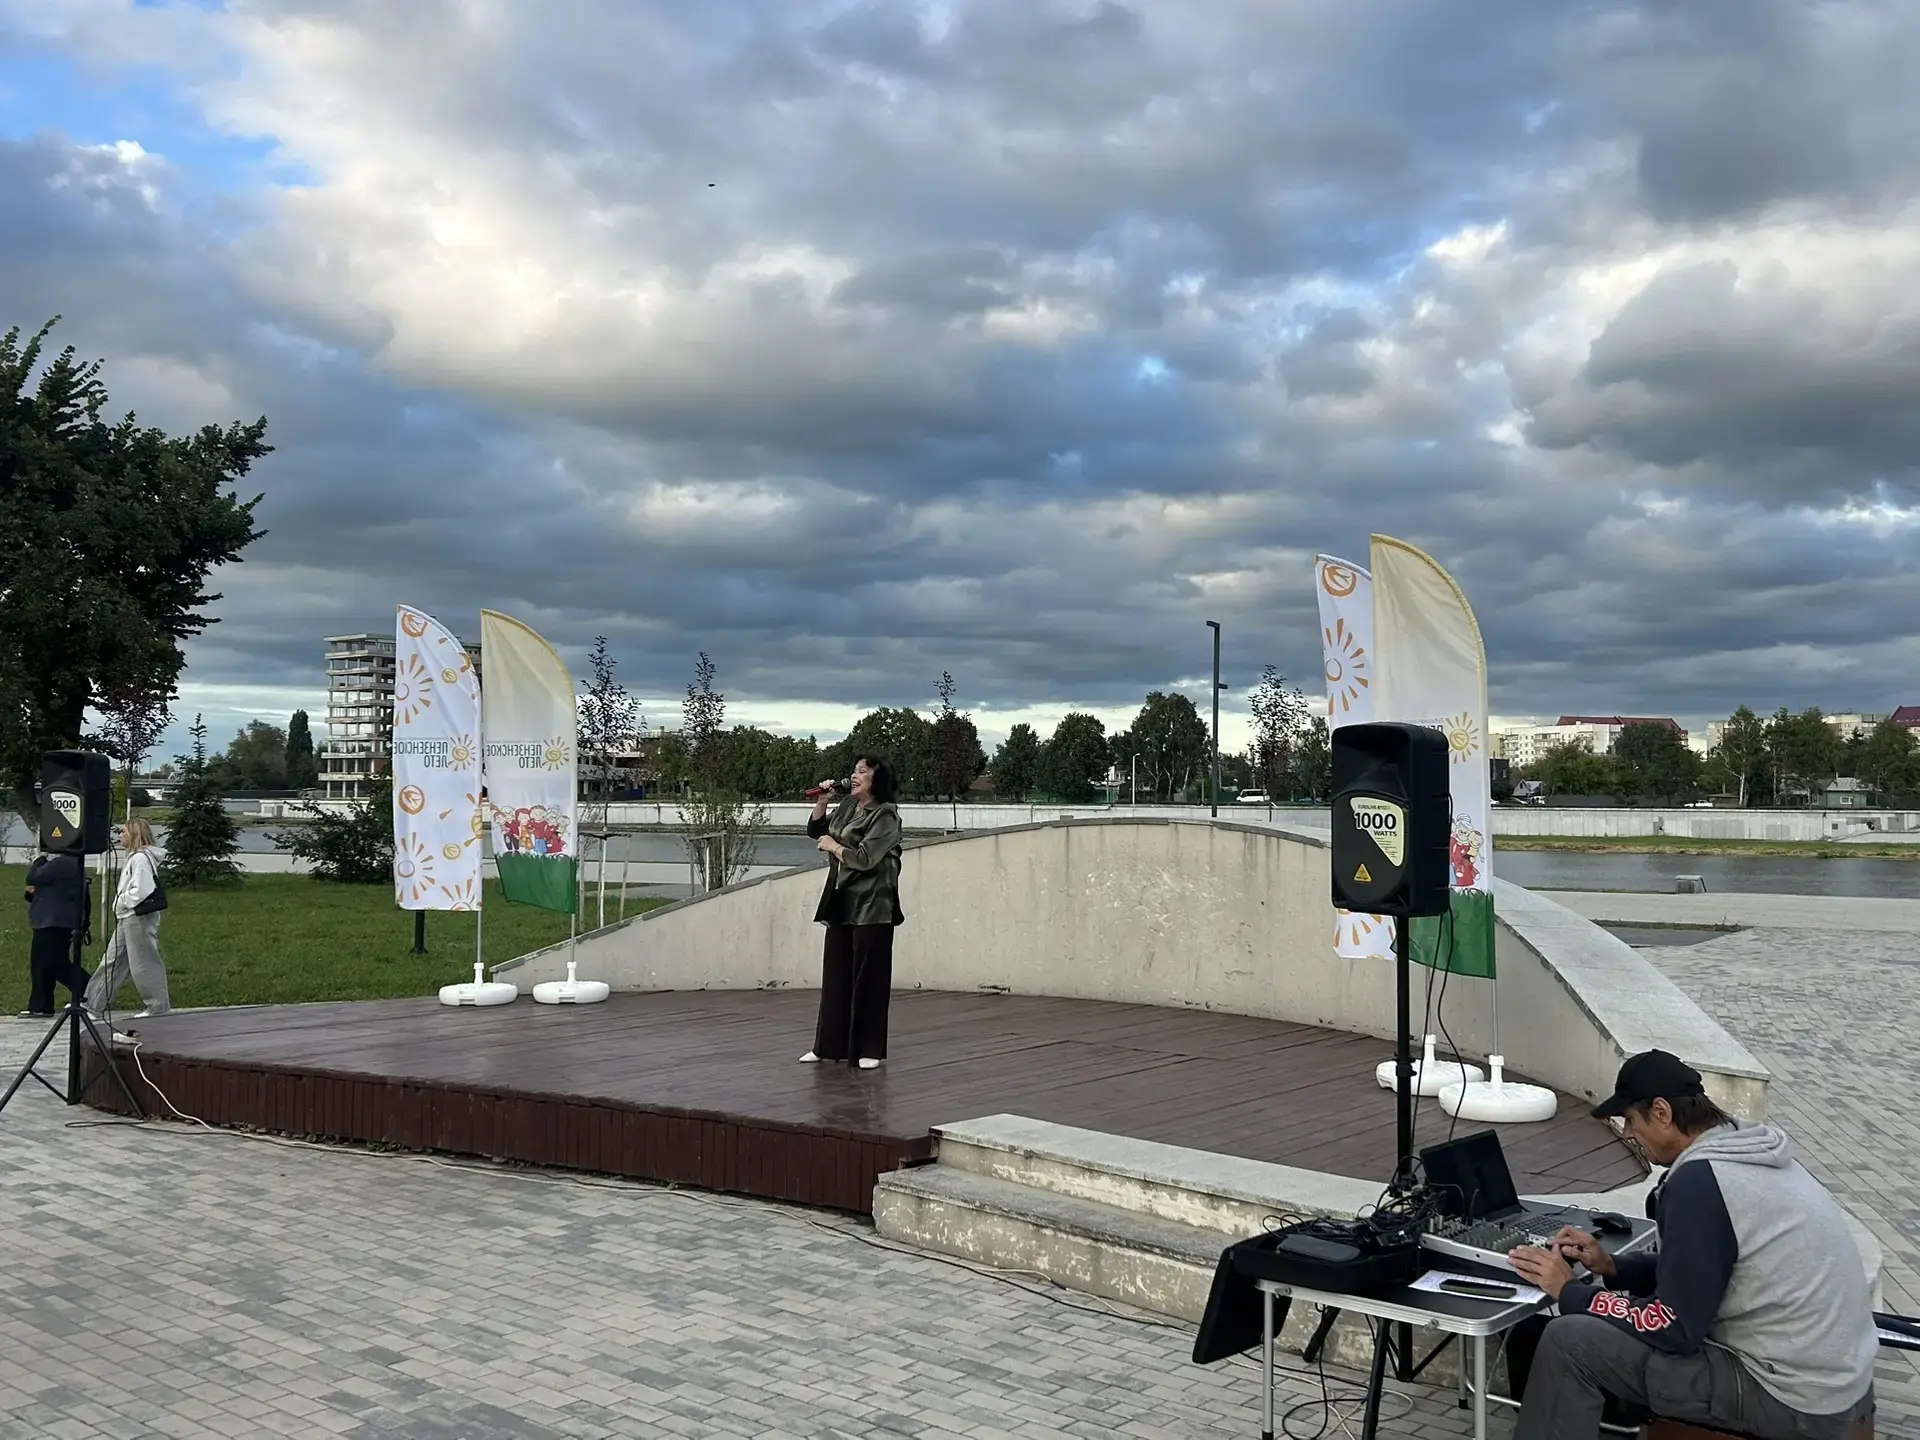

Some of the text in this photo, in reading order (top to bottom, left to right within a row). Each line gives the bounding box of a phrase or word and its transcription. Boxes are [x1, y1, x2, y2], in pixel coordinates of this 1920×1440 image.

[53, 800, 76, 809] 1000
[1355, 813, 1397, 829] 1000
[1587, 1291, 1677, 1331] Bench
